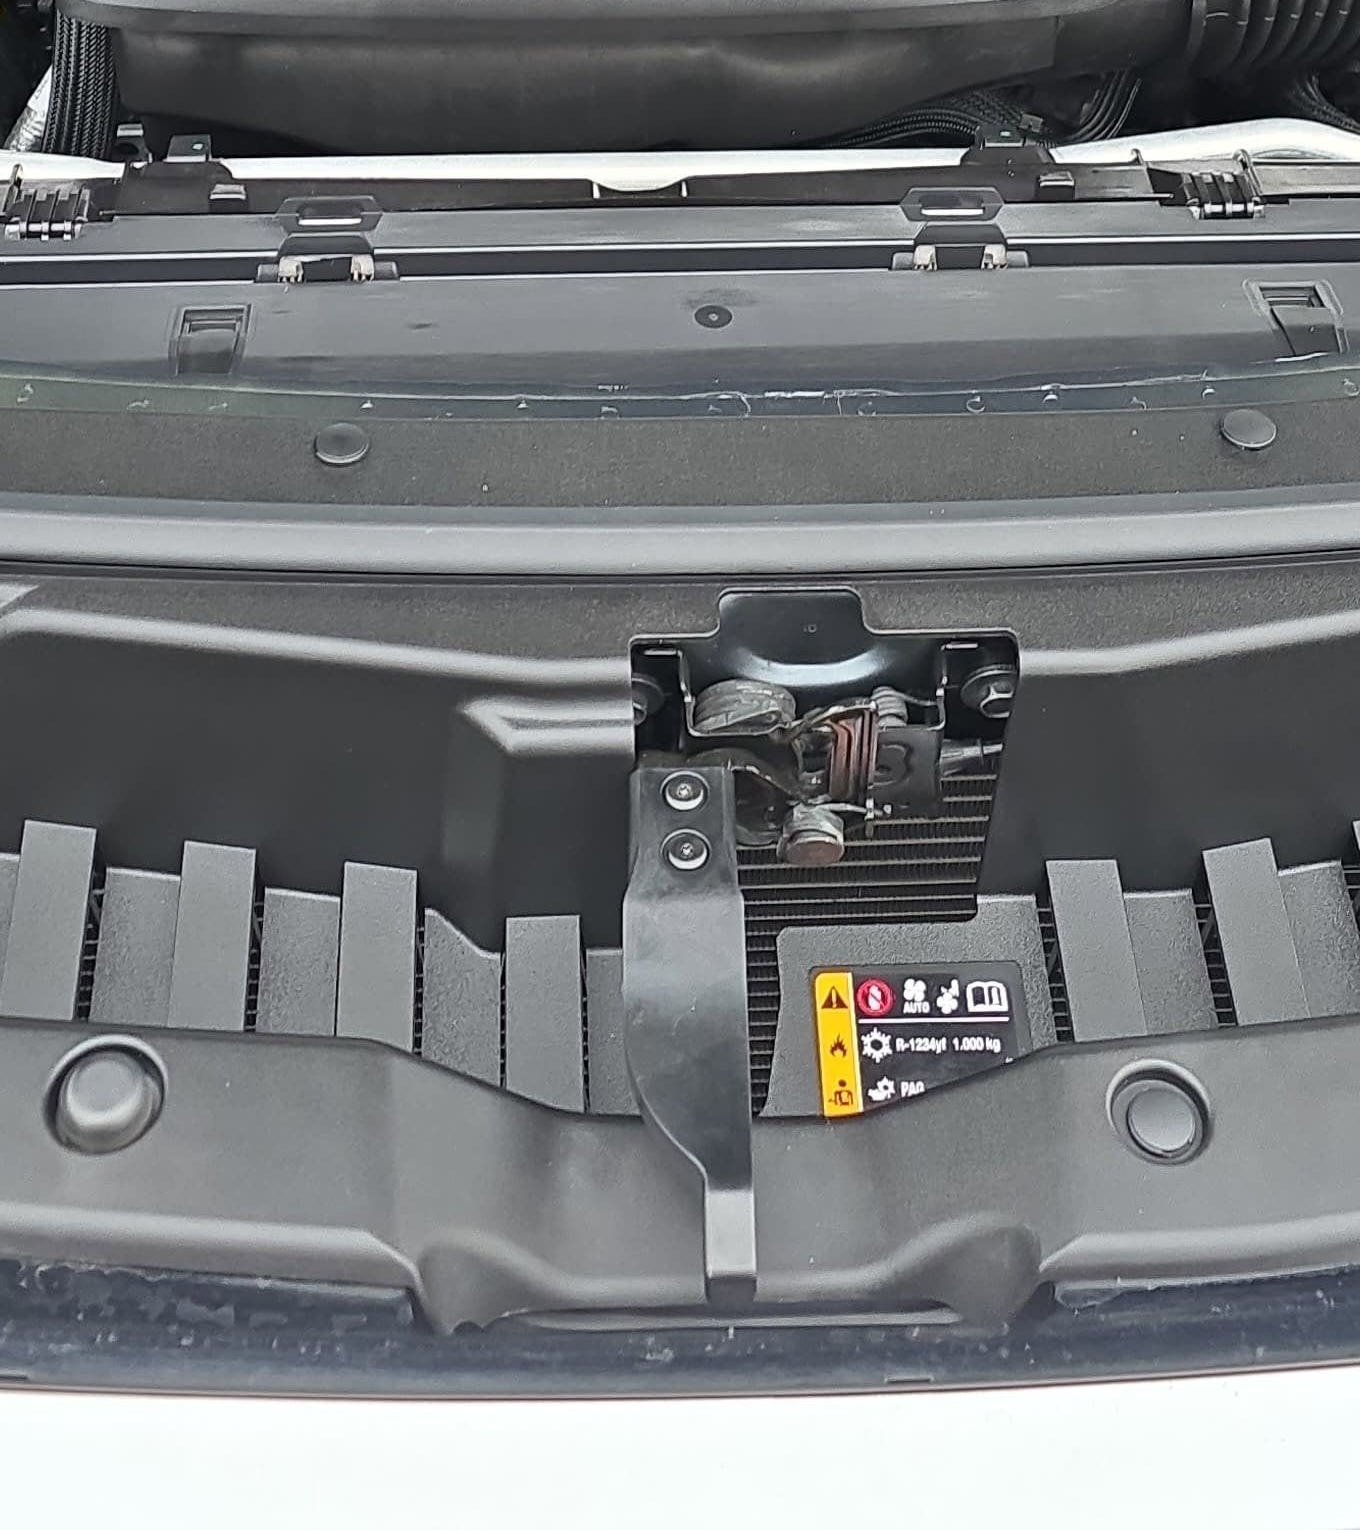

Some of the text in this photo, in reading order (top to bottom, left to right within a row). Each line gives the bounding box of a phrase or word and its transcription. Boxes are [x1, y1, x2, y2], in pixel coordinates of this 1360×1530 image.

[903, 1001, 931, 1014] AUTO
[895, 1036, 1001, 1054] R-1234yf 1.000 kg
